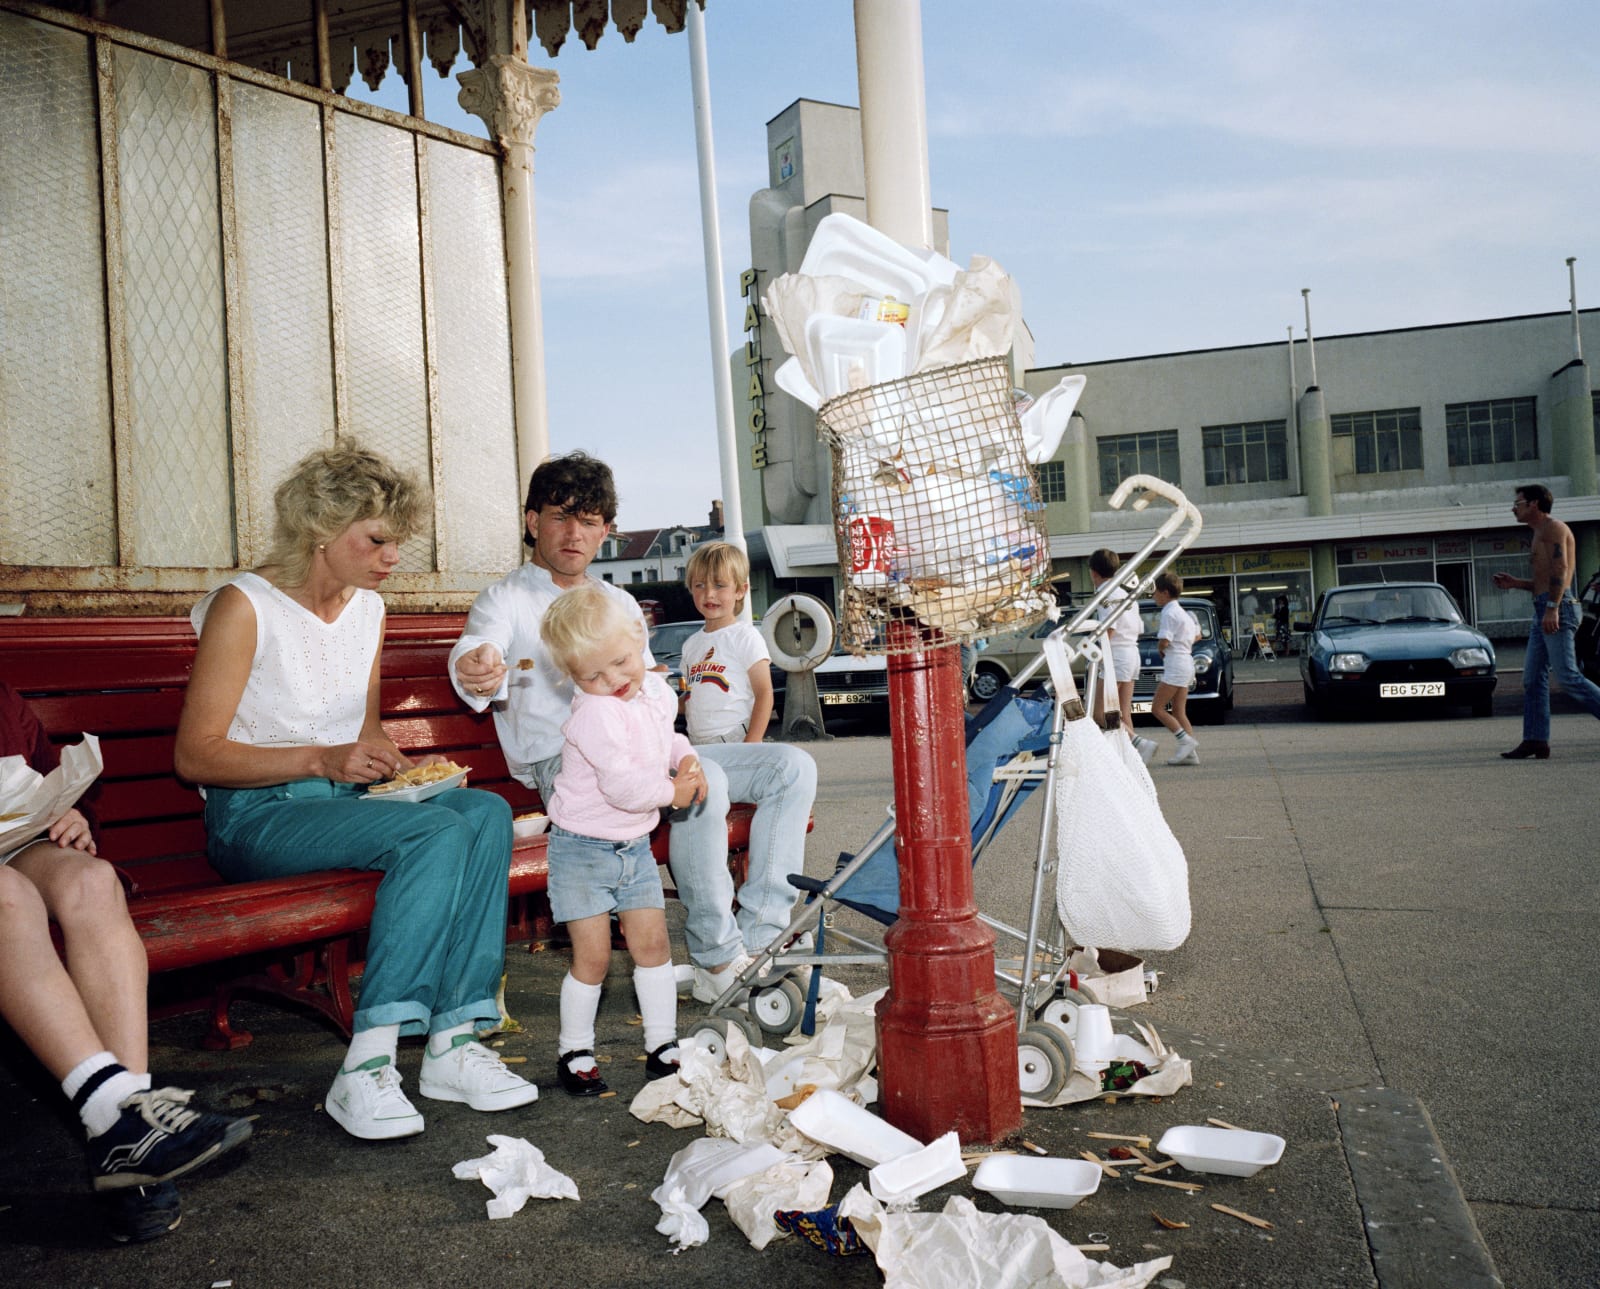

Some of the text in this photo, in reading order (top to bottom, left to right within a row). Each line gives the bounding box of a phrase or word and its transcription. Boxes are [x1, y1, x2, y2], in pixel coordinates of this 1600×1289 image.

[740, 268, 767, 470] PALACE
[1356, 547, 1428, 560] DONUTS
[1175, 557, 1225, 567] PERFECT
[690, 664, 726, 675] SAILING
[1382, 684, 1442, 695] FBG 572Y
[825, 695, 843, 703] PHF
